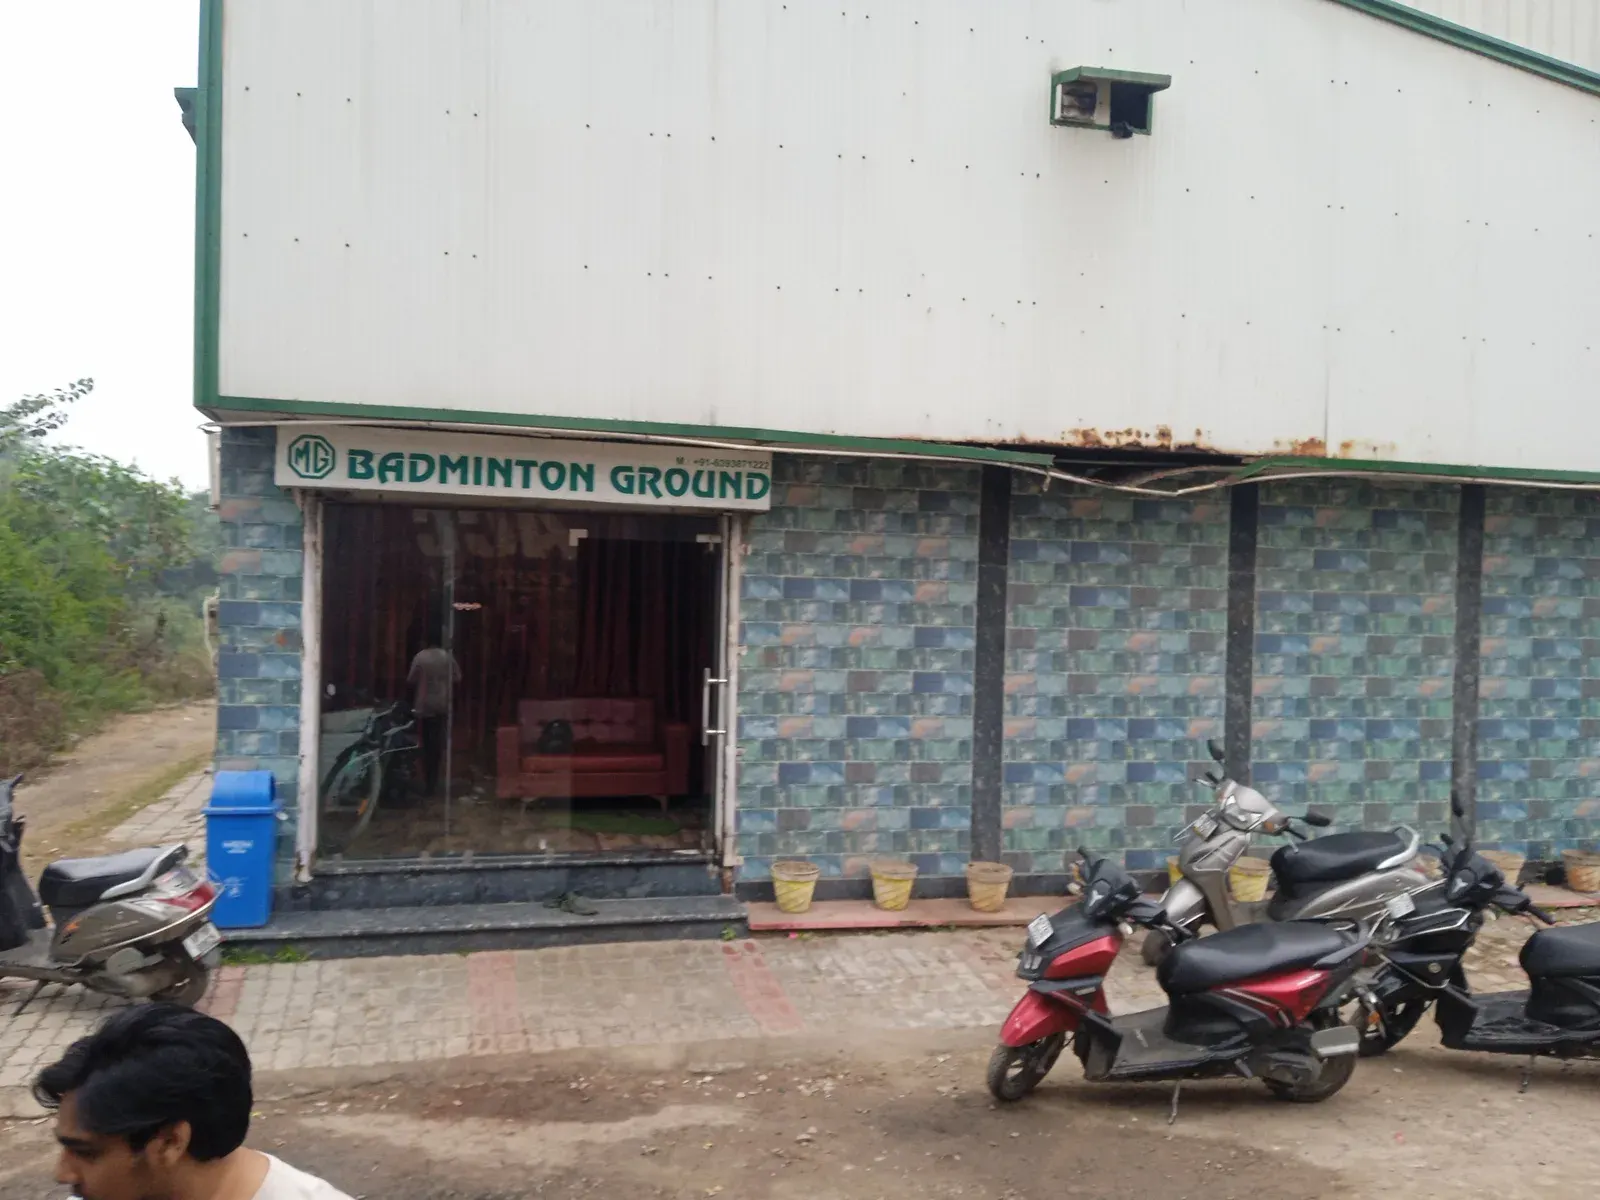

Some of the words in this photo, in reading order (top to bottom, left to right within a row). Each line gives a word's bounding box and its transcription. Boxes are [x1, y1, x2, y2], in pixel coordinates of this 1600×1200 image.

[294, 440, 331, 474] MG
[347, 448, 595, 493] BADMINTON
[610, 465, 771, 500] GROUND
